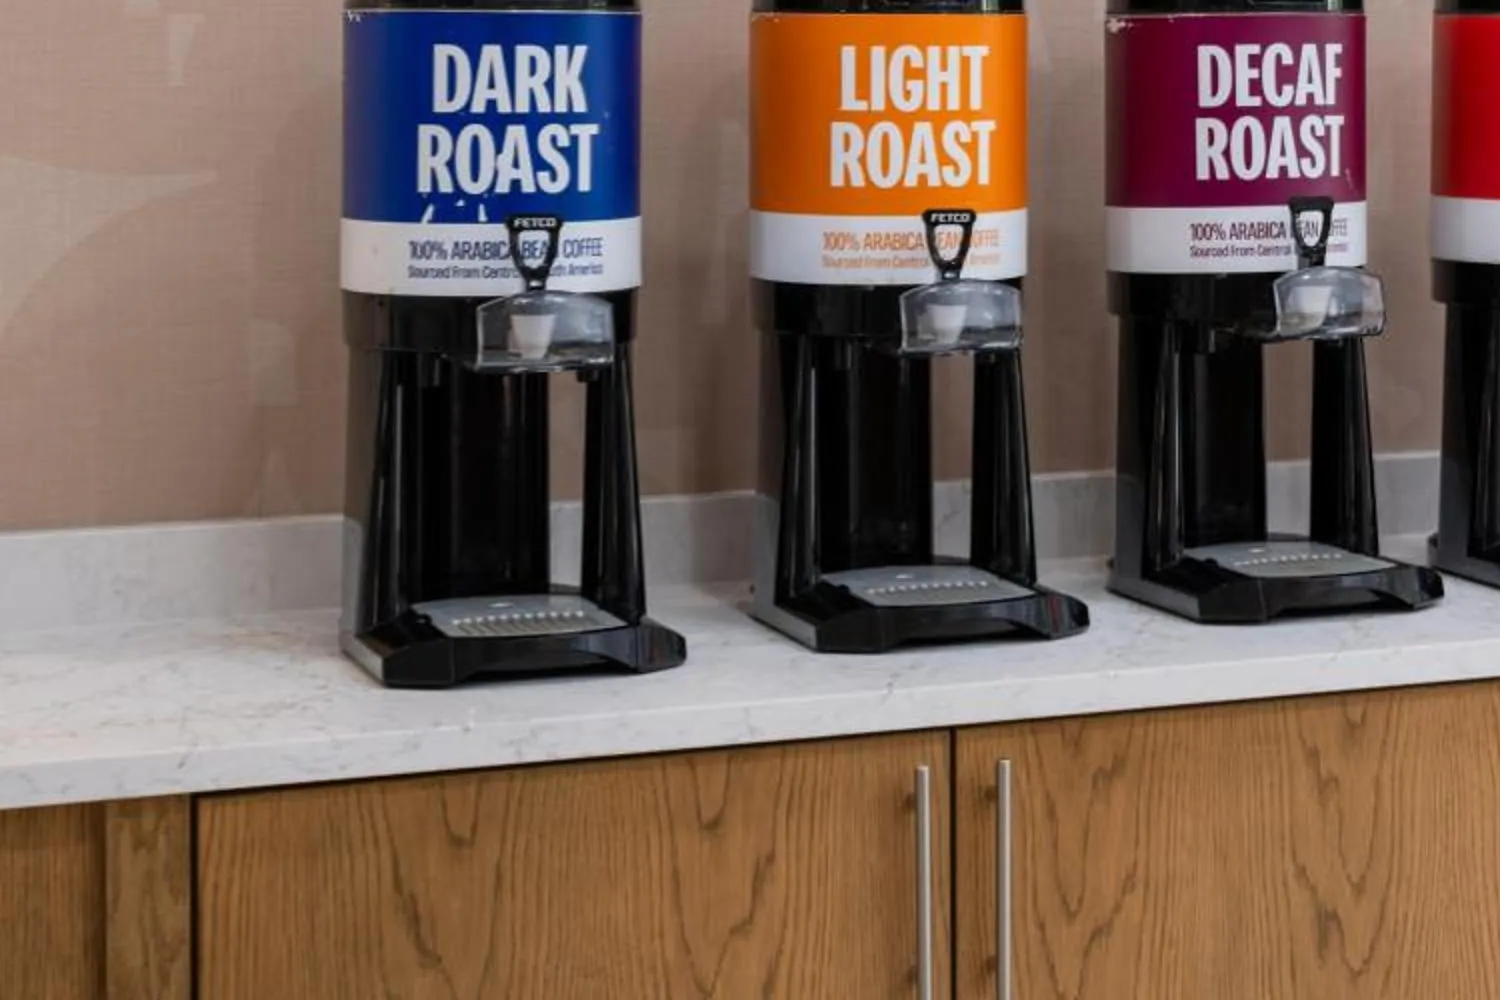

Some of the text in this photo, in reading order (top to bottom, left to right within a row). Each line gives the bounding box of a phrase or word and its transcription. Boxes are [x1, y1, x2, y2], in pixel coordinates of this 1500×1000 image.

[432, 44, 588, 114] DARK
[840, 45, 990, 112] LIGHT
[1197, 42, 1342, 108] DECAF
[417, 124, 599, 194] ROAST
[830, 120, 996, 188] ROAST
[1195, 115, 1344, 180] ROAST
[409, 240, 447, 261] 100%
[451, 239, 510, 261] ARABIC
[563, 237, 604, 258] COFFEE
[514, 217, 557, 228] FETCO
[822, 231, 860, 251] 100%
[863, 231, 925, 251] ARABICA
[930, 212, 971, 223] FETCO
[1190, 223, 1227, 241] 100%
[1229, 221, 1287, 241] ARABICA
